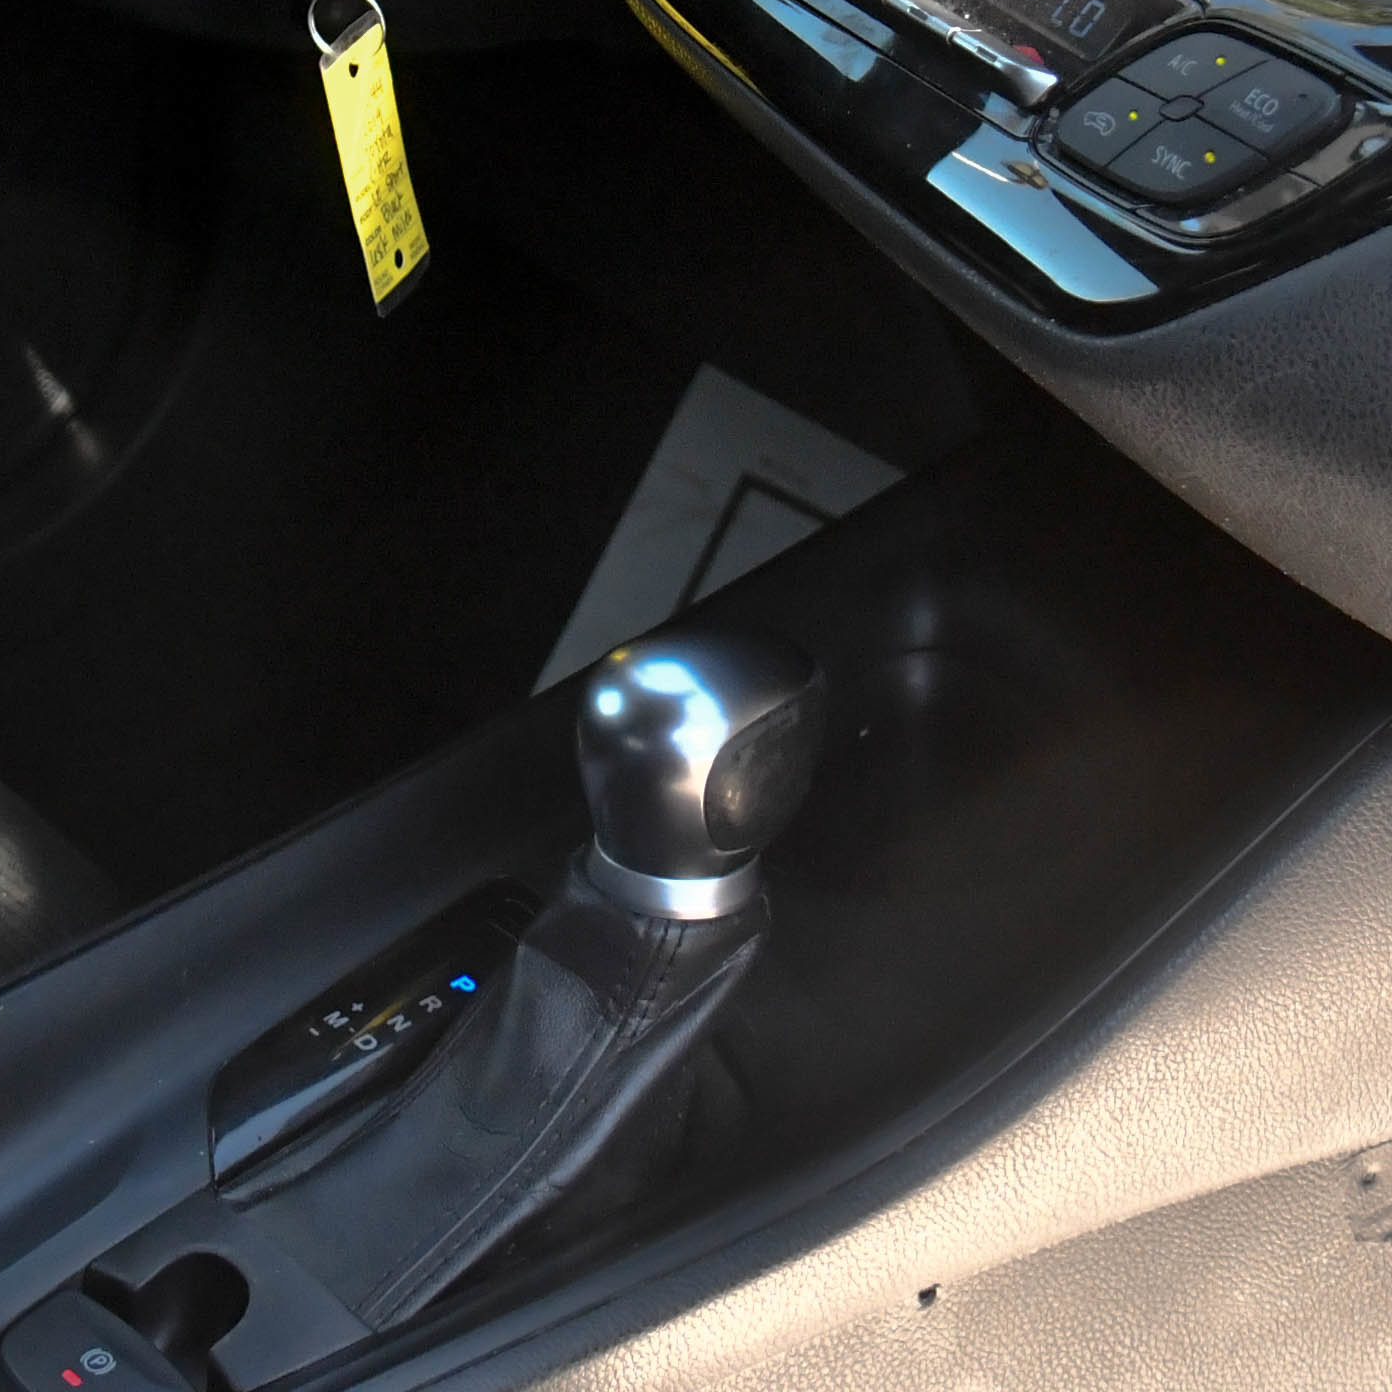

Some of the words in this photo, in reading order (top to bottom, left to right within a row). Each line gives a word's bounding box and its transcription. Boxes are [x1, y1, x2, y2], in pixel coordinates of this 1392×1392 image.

[1167, 52, 1198, 77] A/C
[1243, 86, 1280, 117] ECO
[1150, 145, 1193, 181] SYNC
[450, 974, 476, 992] P
[419, 995, 442, 1013] R
[323, 1010, 349, 1028] M
[387, 1013, 411, 1032] N
[354, 1033, 378, 1050] D
